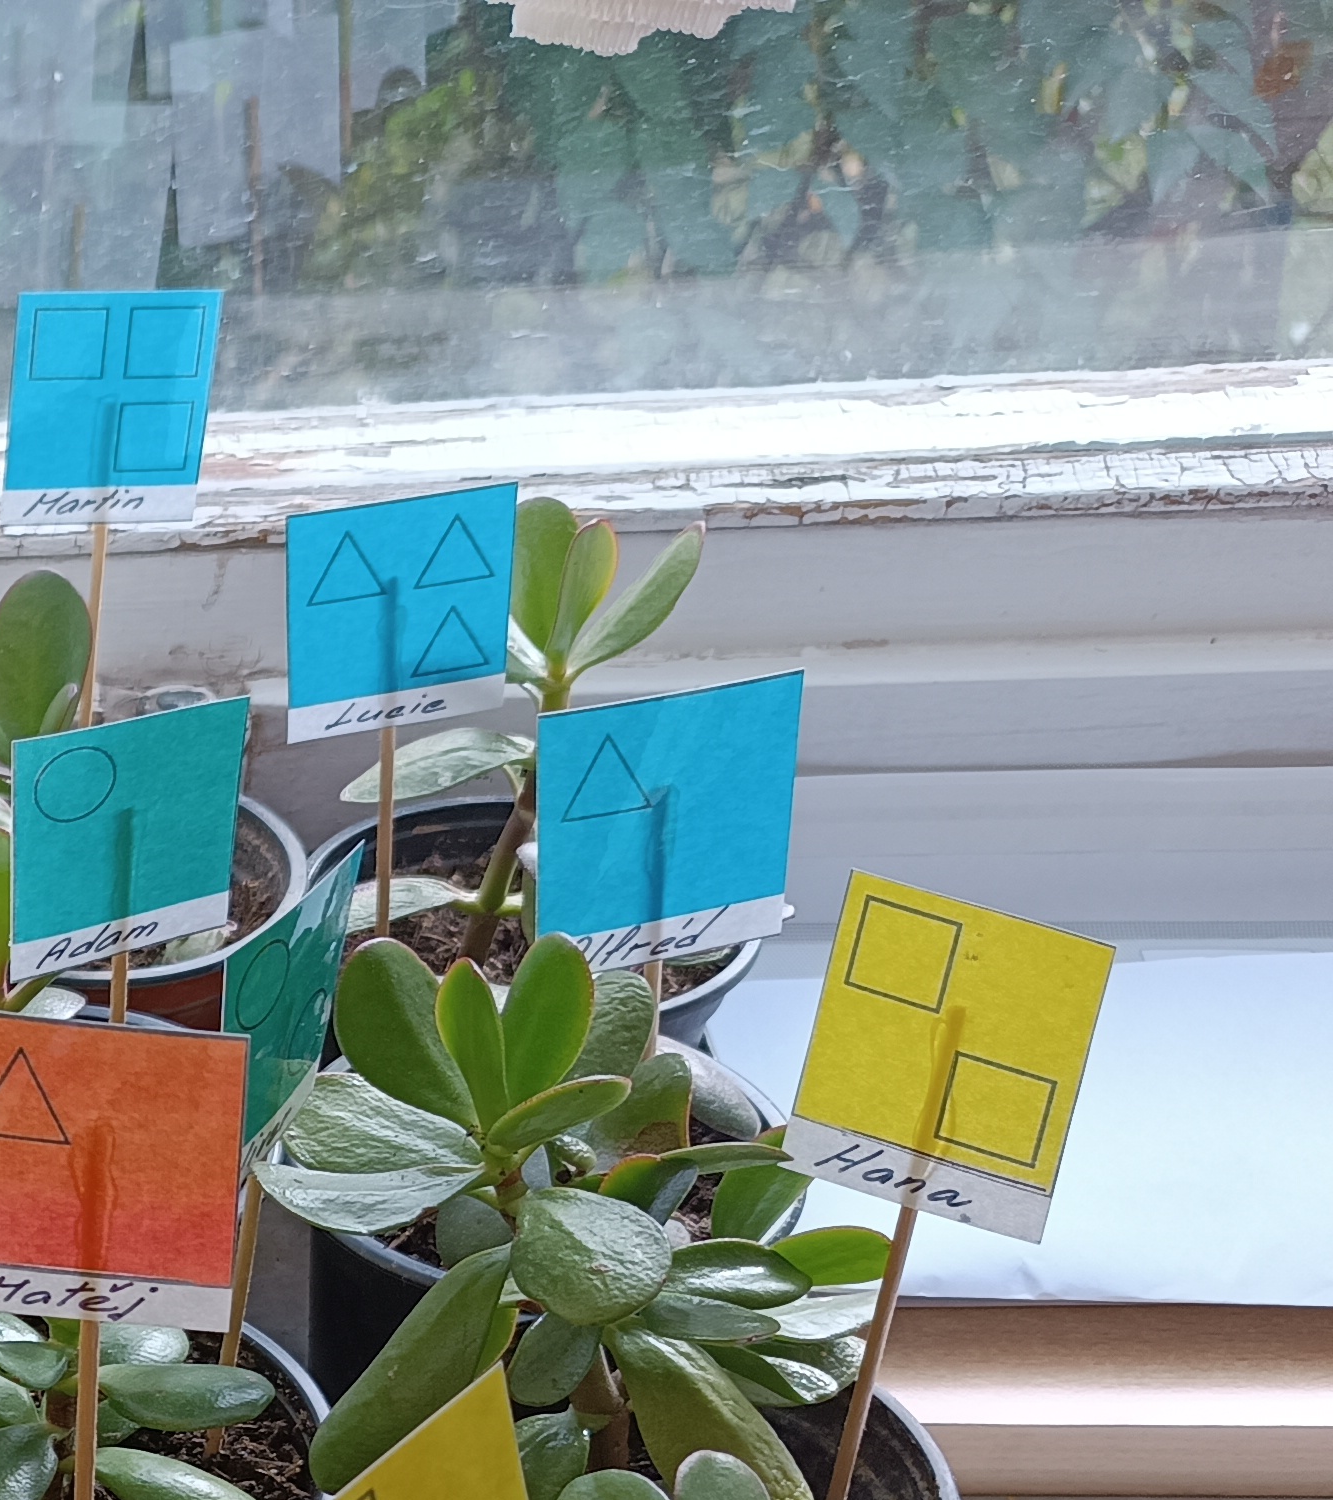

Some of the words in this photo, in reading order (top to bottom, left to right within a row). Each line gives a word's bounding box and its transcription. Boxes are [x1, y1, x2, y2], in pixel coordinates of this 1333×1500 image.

[22, 489, 145, 519] Martin
[324, 693, 449, 731] Lucie
[35, 919, 159, 970] Adam
[813, 1144, 973, 1208] Hana
